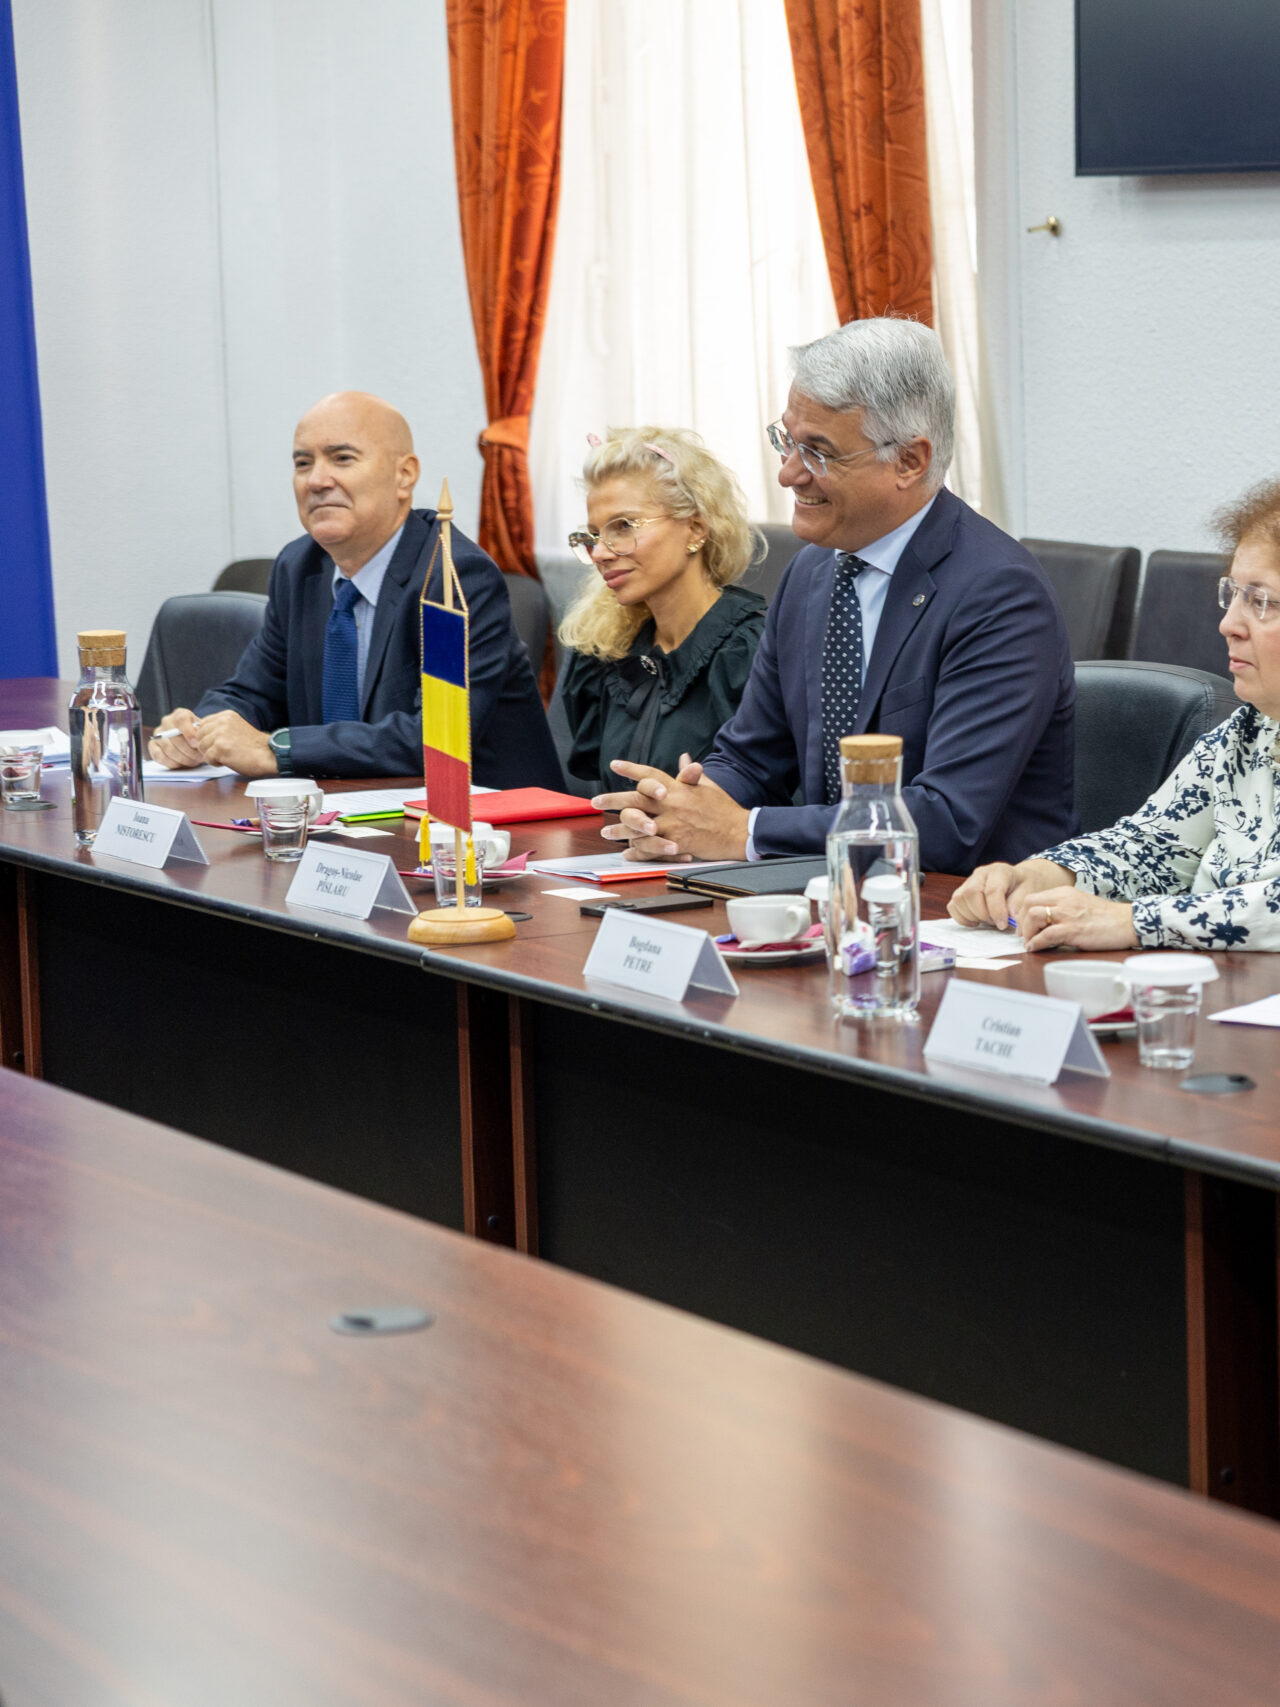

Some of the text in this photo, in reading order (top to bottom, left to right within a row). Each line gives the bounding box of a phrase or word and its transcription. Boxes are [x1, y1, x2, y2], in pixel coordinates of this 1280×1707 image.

[628, 935, 662, 956] Bogdana
[622, 954, 653, 974] PETRE
[981, 1016, 1022, 1038] Cristian
[974, 1036, 1016, 1059] TACHE
